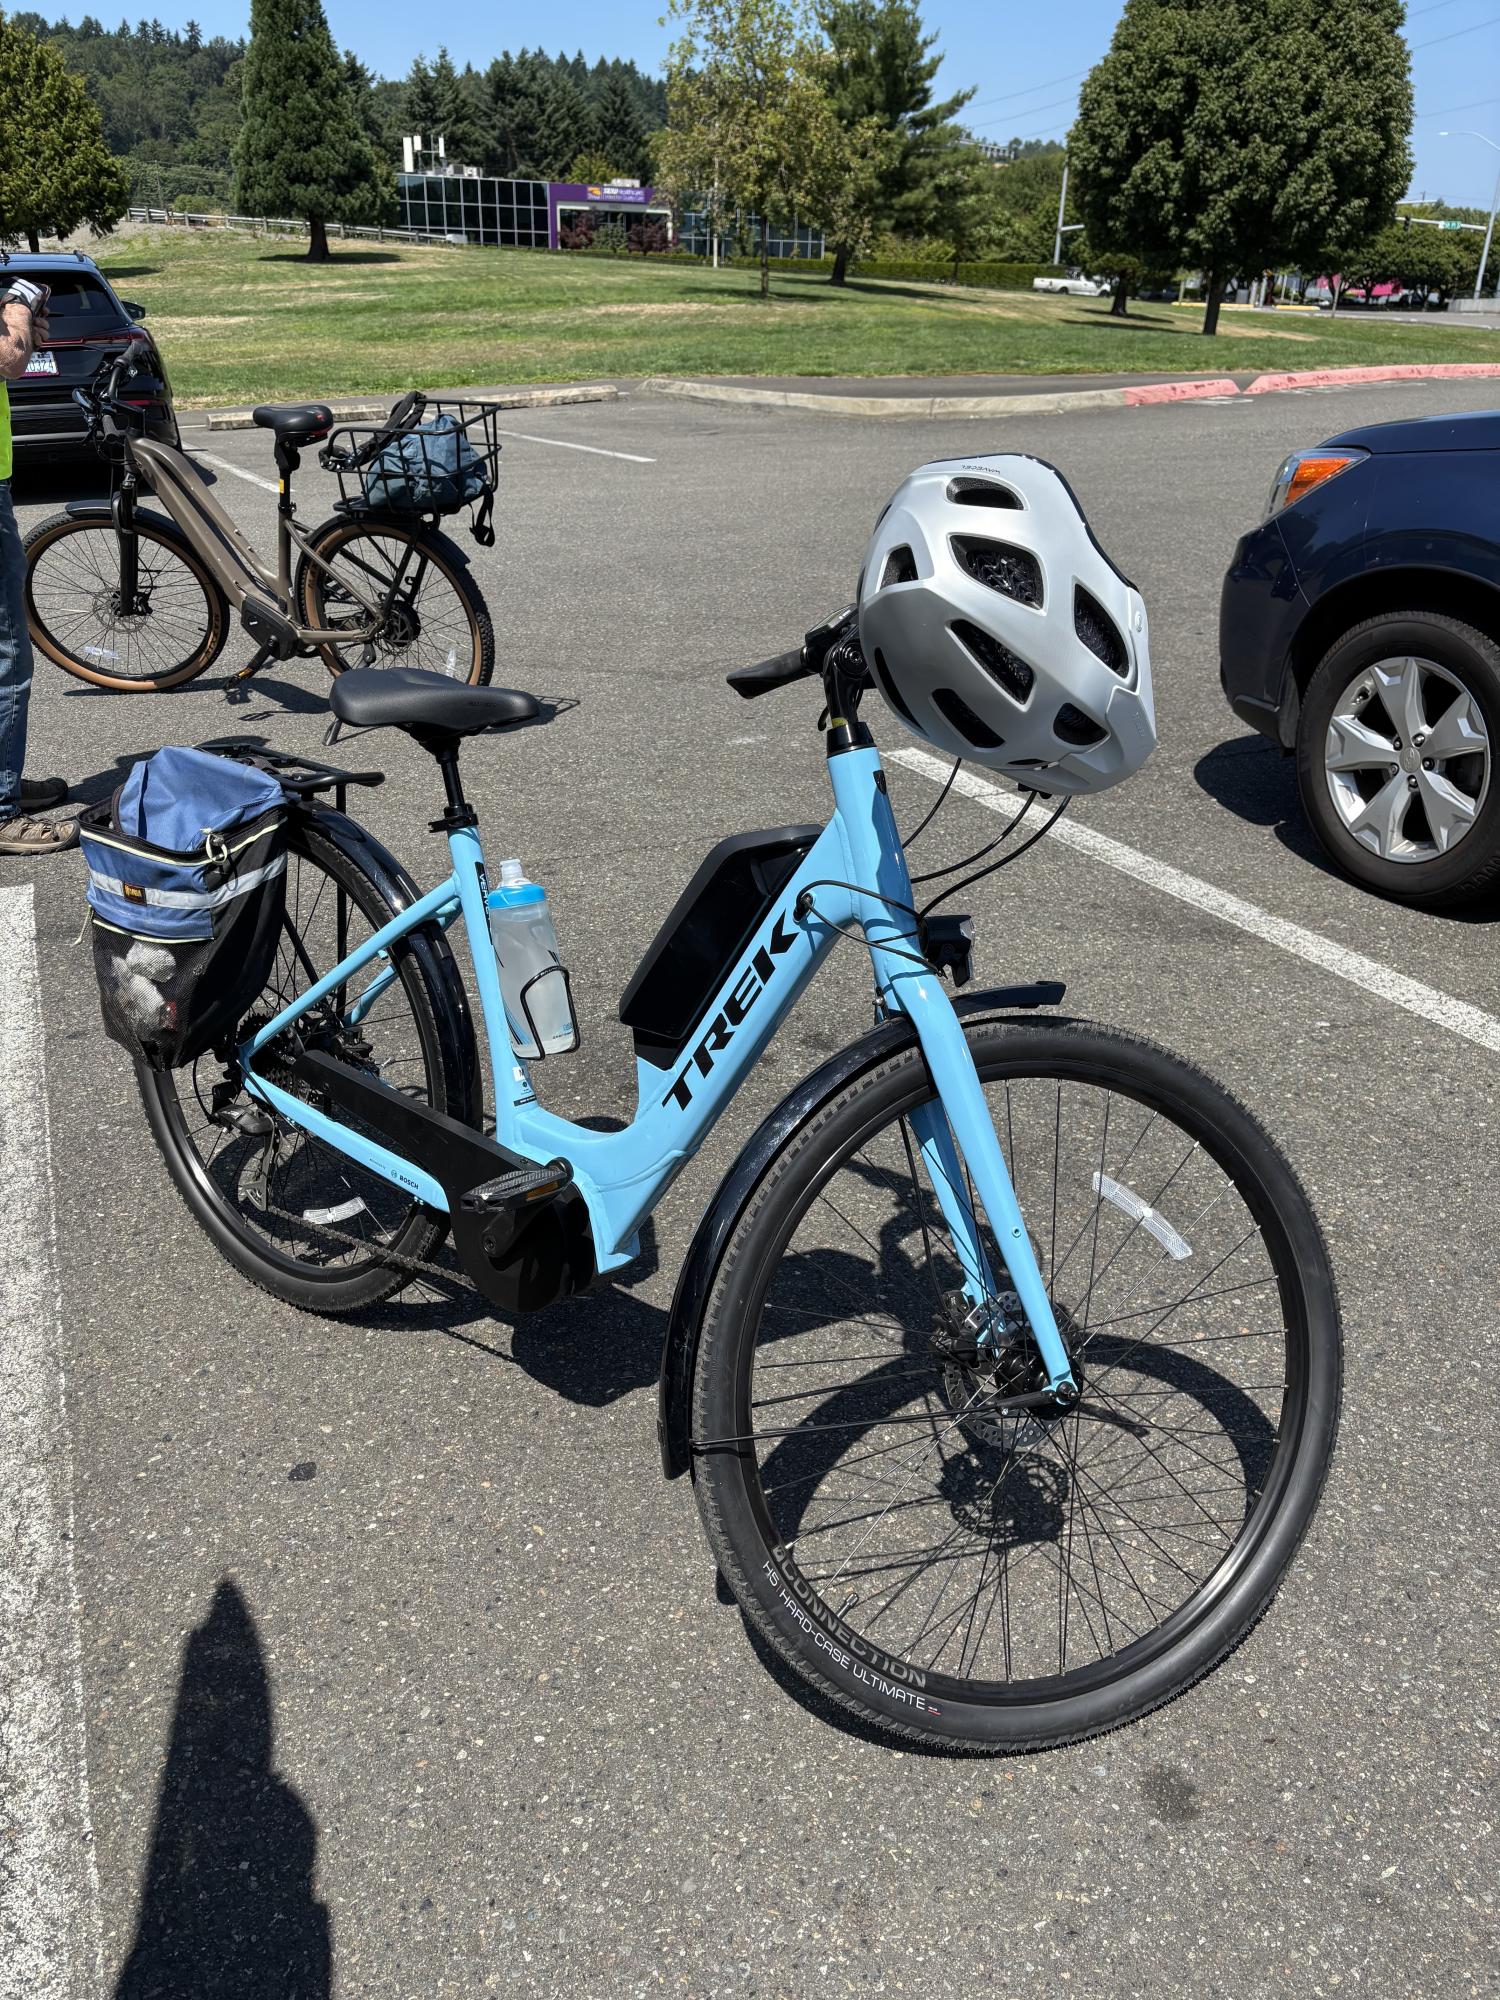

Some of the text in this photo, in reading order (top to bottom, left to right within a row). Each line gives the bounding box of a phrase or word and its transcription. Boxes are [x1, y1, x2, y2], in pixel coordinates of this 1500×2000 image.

[662, 909, 800, 1111] TREK
[399, 1174, 419, 1190] BOSCH
[779, 1588, 851, 1670] HARD-CASE
[853, 1663, 926, 1711] ULTIMATE
[781, 1560, 926, 1688] CONNECTION
